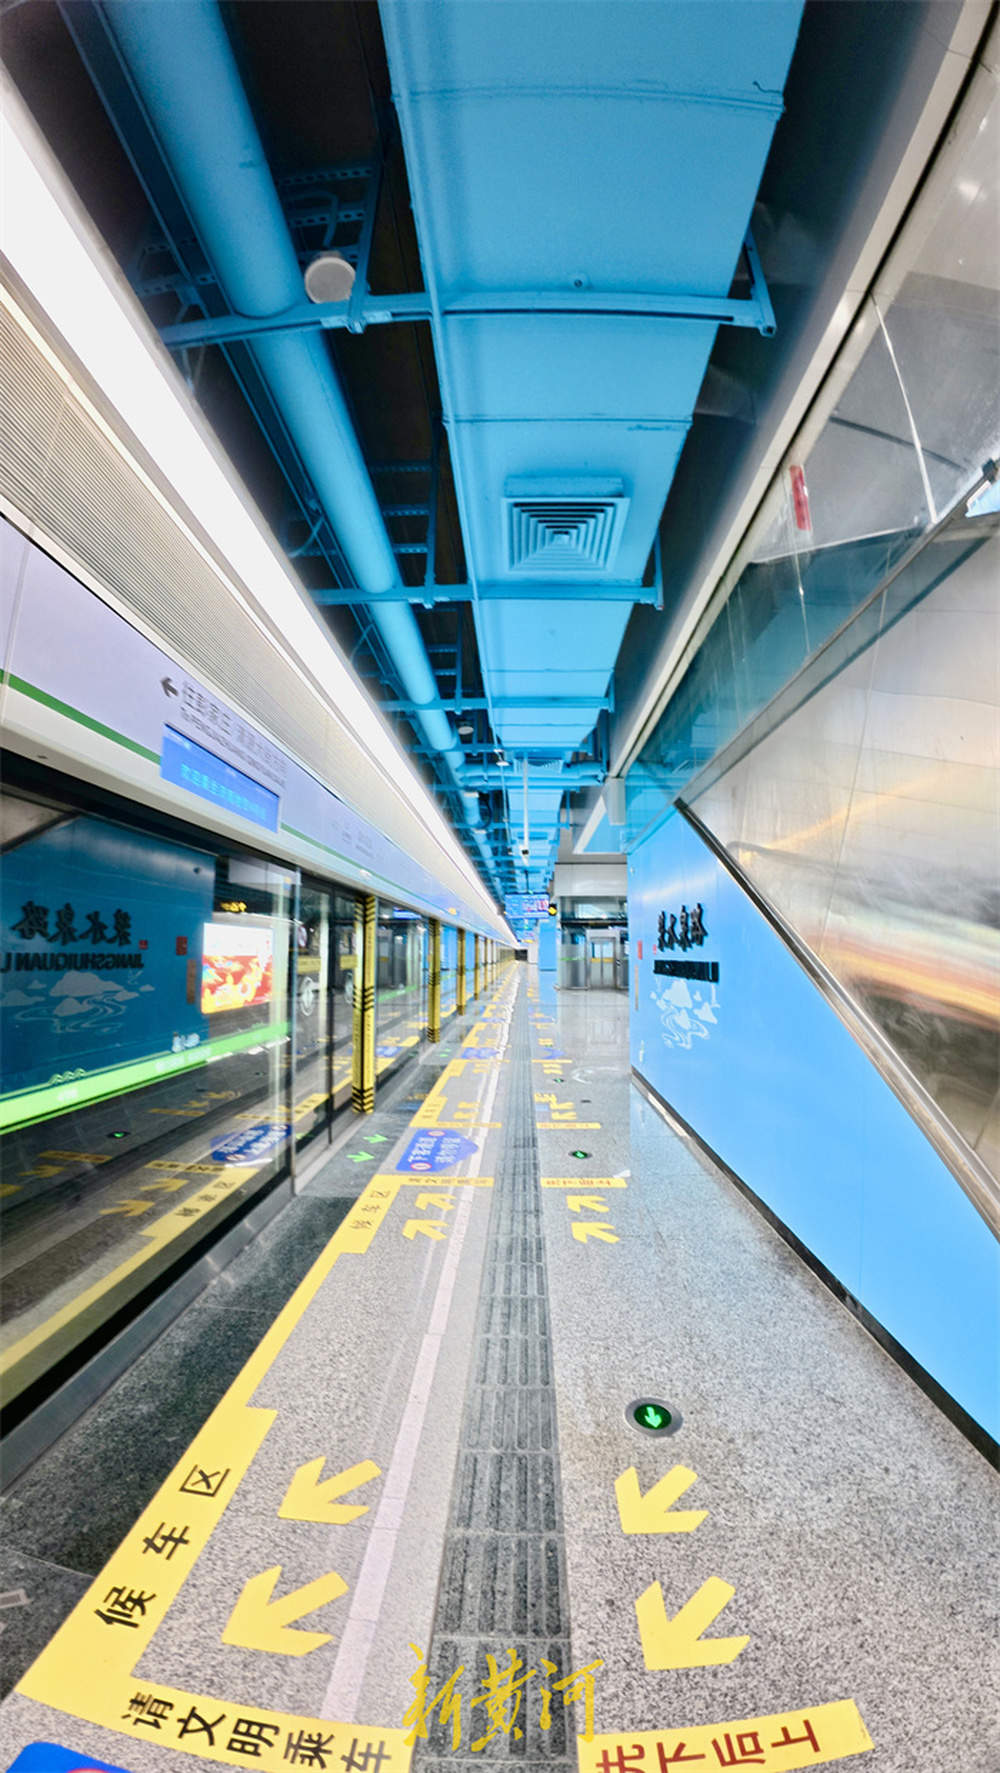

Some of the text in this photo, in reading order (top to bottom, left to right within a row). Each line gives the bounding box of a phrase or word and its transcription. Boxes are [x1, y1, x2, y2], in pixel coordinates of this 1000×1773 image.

[94, 1464, 231, 1629] 候车区
[121, 1692, 392, 1773] 请文明乘车
